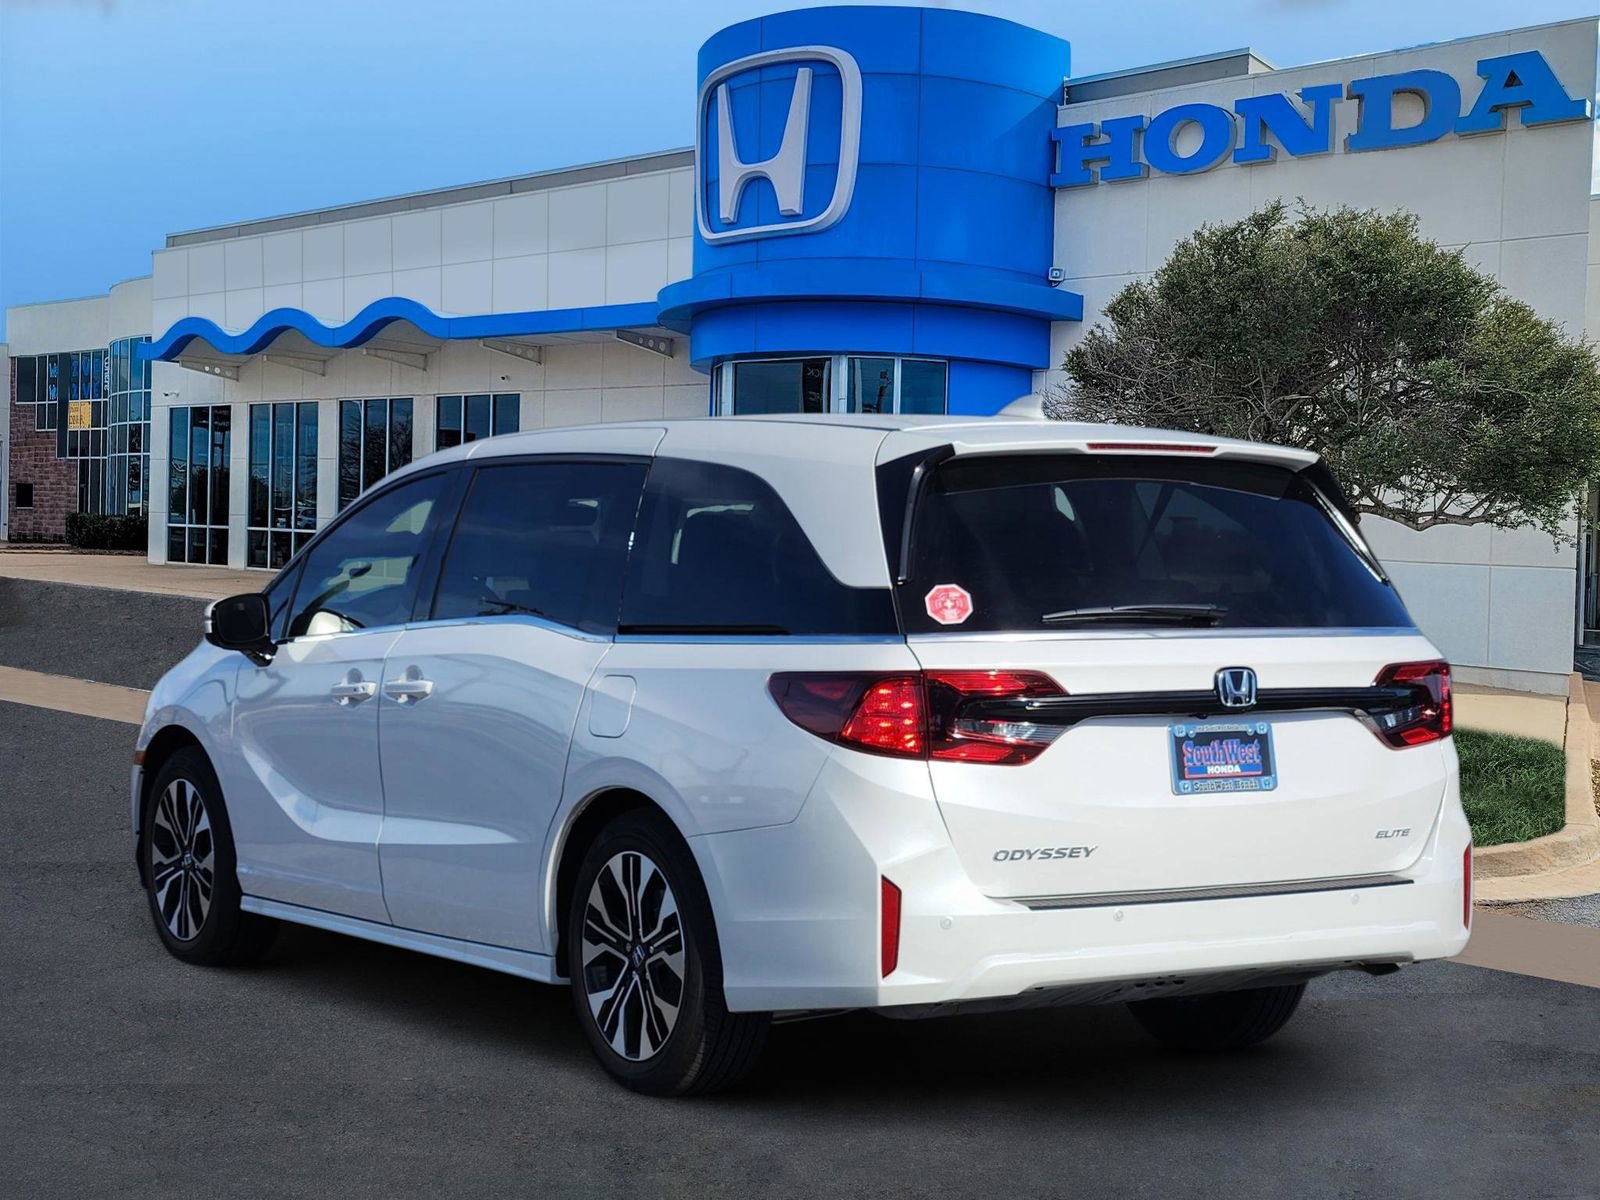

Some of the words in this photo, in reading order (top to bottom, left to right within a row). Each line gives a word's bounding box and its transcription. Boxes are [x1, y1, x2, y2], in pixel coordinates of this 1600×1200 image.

[1050, 49, 1591, 188] HONDA
[1182, 738, 1262, 766] SouthWest
[1207, 764, 1241, 774] HONDA
[1375, 828, 1411, 839] ELITE
[993, 845, 1099, 862] ODYSSEY
